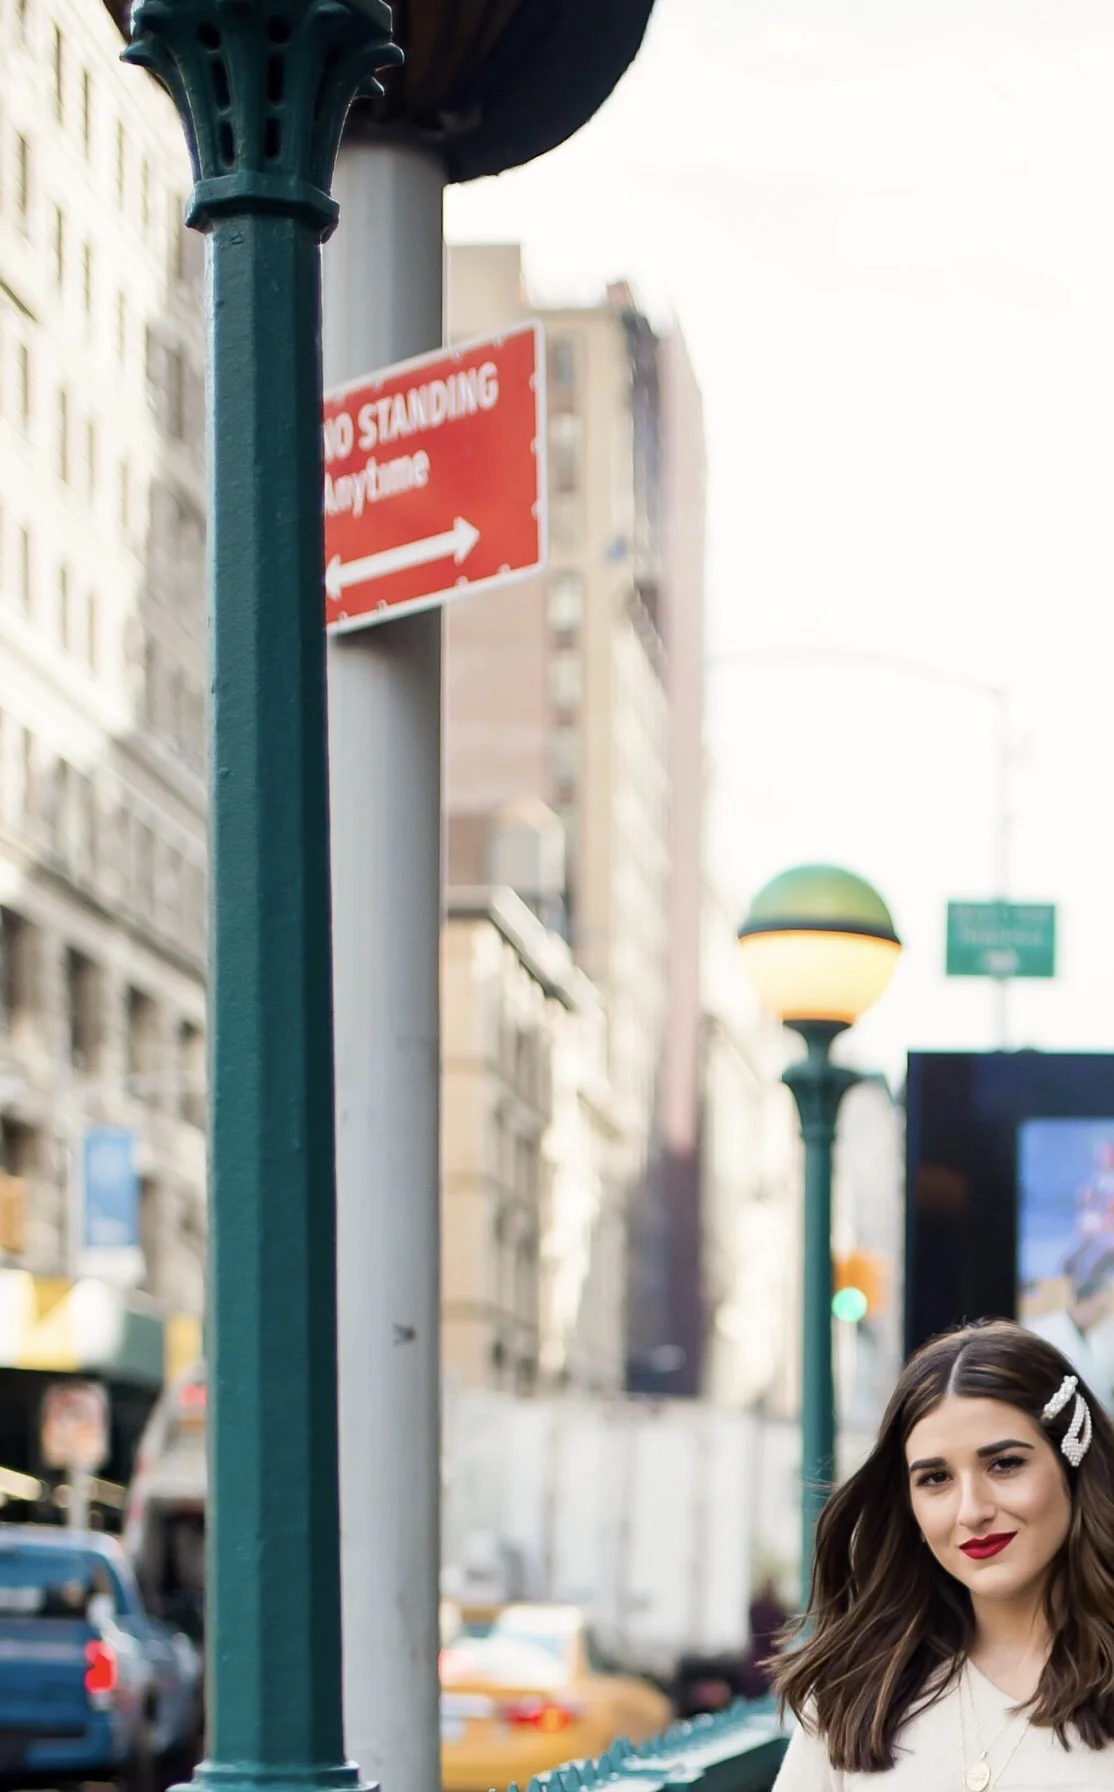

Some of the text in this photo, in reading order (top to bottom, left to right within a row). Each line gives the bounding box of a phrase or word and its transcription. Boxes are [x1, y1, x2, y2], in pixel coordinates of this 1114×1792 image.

[323, 361, 499, 464] NO STANDING
[324, 449, 431, 518] Anytime
